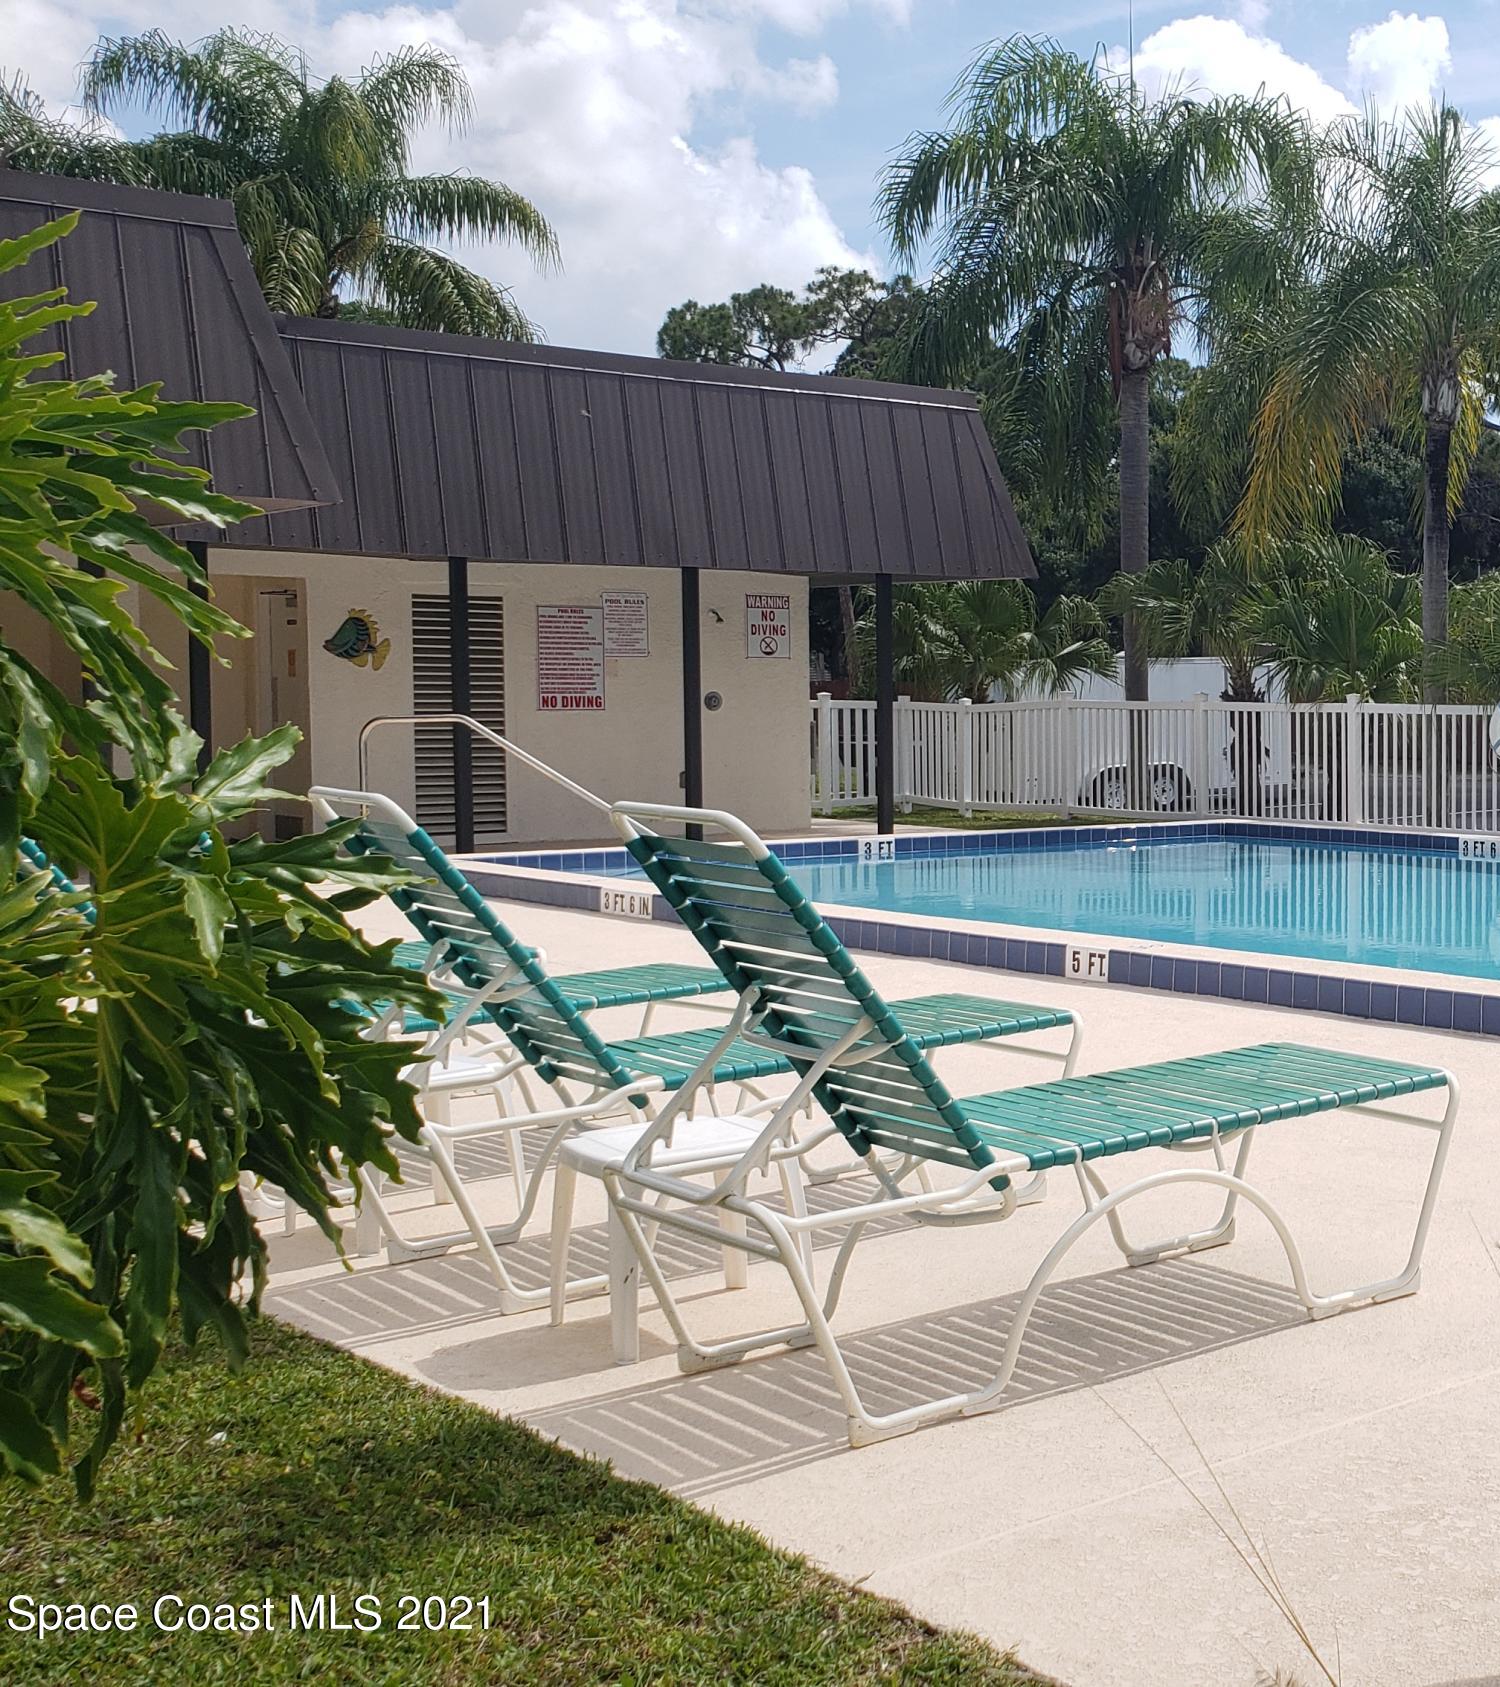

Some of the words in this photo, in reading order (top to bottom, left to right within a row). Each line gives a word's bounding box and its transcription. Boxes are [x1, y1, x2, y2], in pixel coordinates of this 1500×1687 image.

[747, 595, 789, 608] WARNING
[761, 610, 776, 622] NO
[750, 623, 786, 636] DIVING
[541, 695, 558, 708] NO
[561, 695, 602, 708] DIVING
[864, 841, 872, 860] 3
[1462, 840, 1469, 857] 3
[1490, 842, 1497, 859] 6
[604, 891, 610, 910] 3
[629, 895, 636, 914] 6
[1071, 950, 1081, 974] 5
[1088, 952, 1106, 977] FT.
